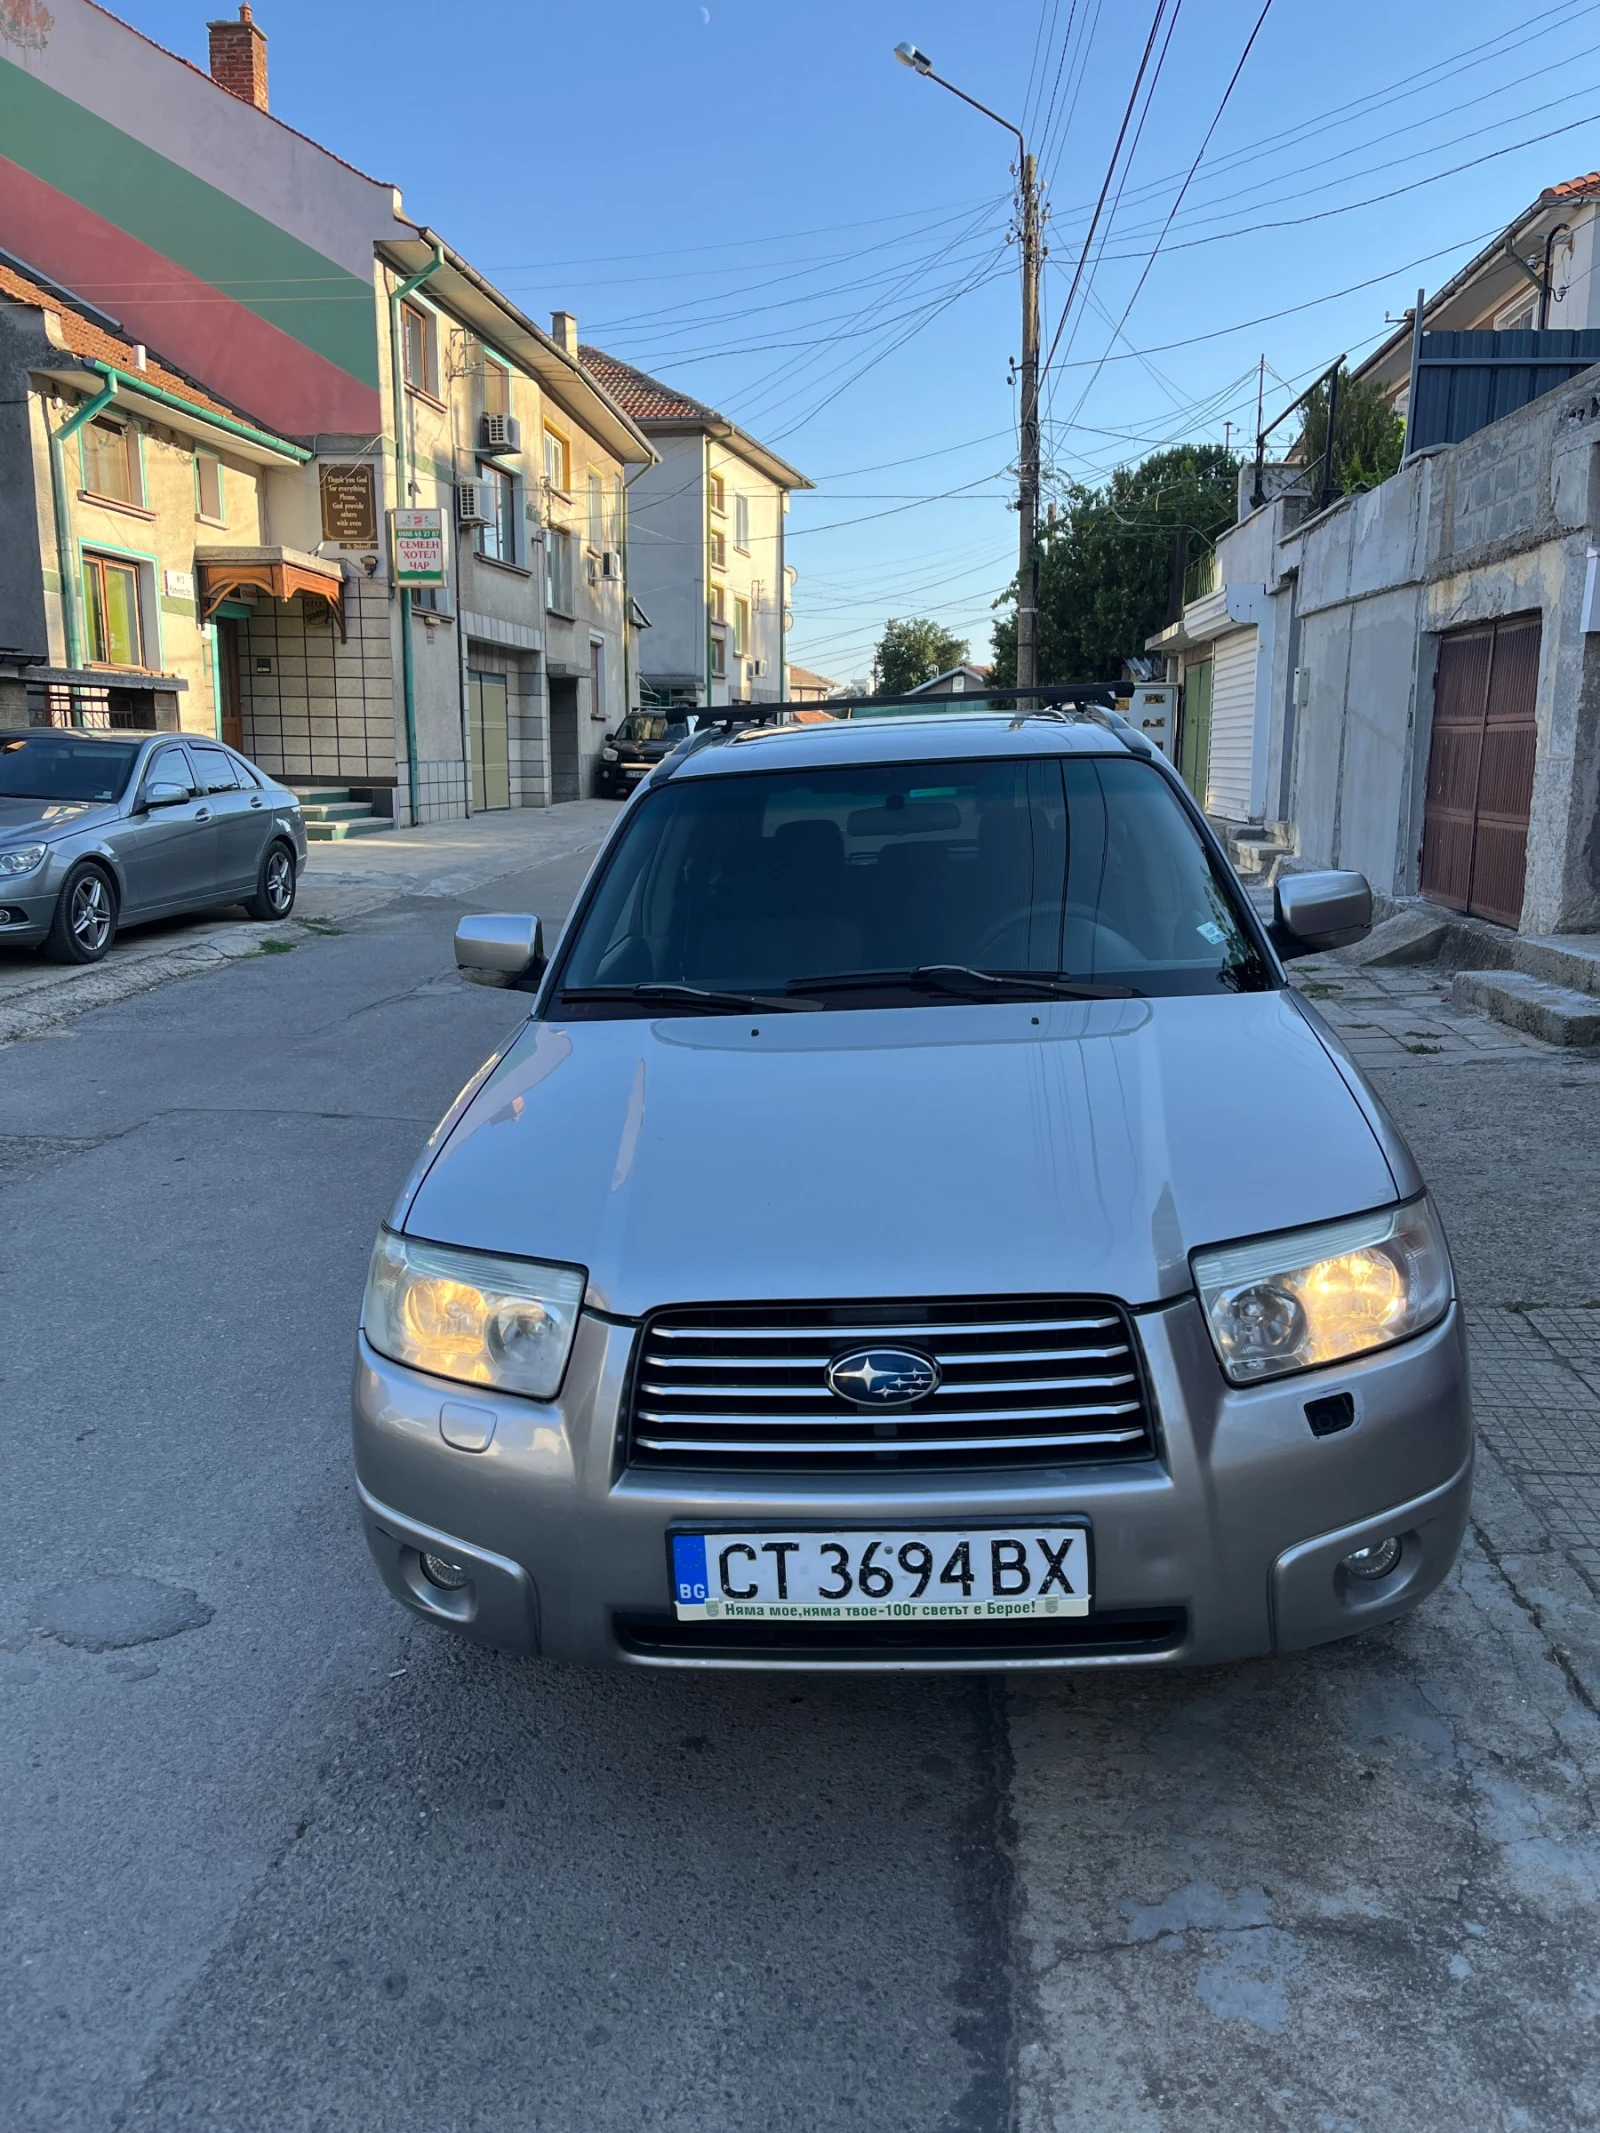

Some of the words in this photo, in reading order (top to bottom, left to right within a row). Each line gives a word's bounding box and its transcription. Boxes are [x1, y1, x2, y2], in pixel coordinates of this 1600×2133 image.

[327, 475, 344, 483] Thank
[356, 475, 368, 483] God
[338, 485, 366, 494] everything
[345, 502, 364, 511] provide
[337, 519, 348, 527] with
[399, 540, 439, 549] СЕМЕЕН
[403, 550, 436, 559] ХОТЕЛ
[409, 561, 430, 570] ЧАР
[818, 1540, 974, 1600] 3694
[679, 1584, 706, 1599] BG
[725, 1603, 765, 1617] Няма
[922, 1604, 969, 1616] светът
[973, 1605, 982, 1615] е
[986, 1600, 1036, 1617] Берое!
